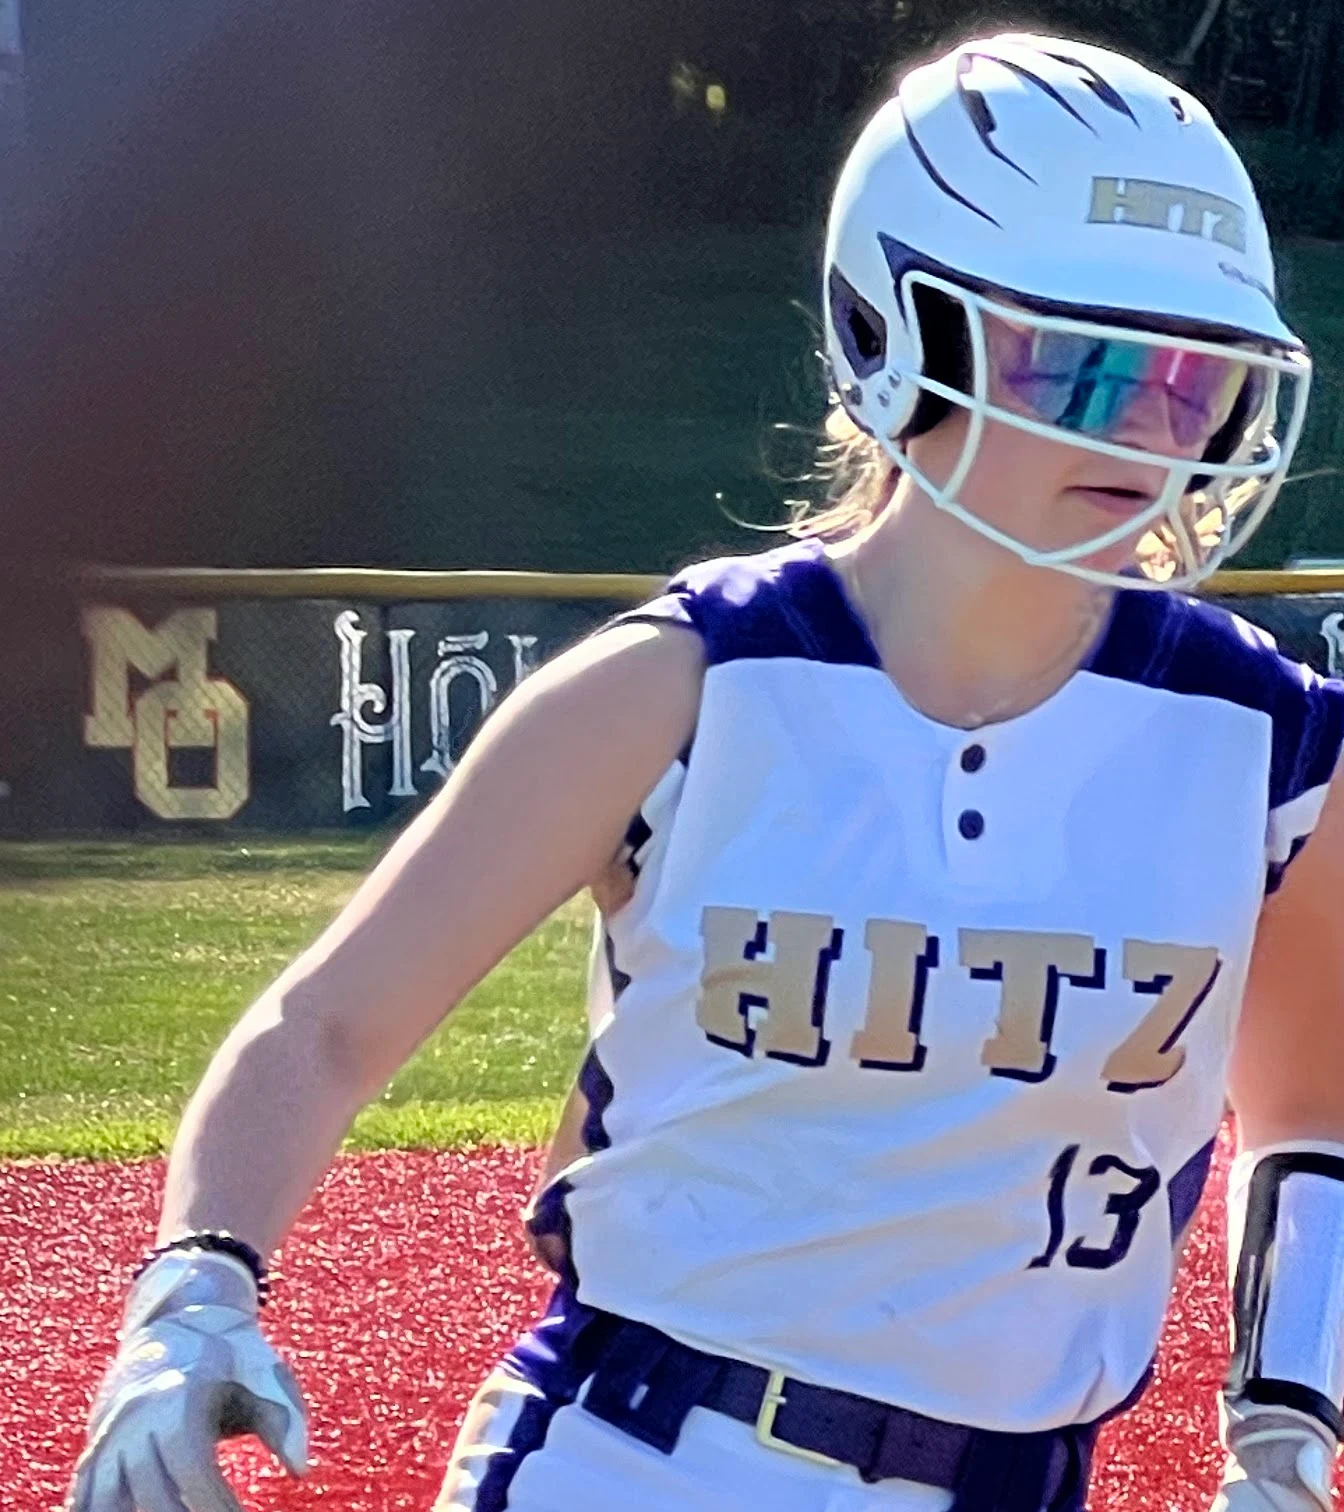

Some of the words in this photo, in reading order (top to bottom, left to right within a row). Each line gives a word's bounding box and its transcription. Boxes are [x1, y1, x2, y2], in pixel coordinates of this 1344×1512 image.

[1087, 176, 1246, 254] HITZ
[697, 905, 1222, 1091] HITZ
[1026, 1144, 1161, 1270] 13
